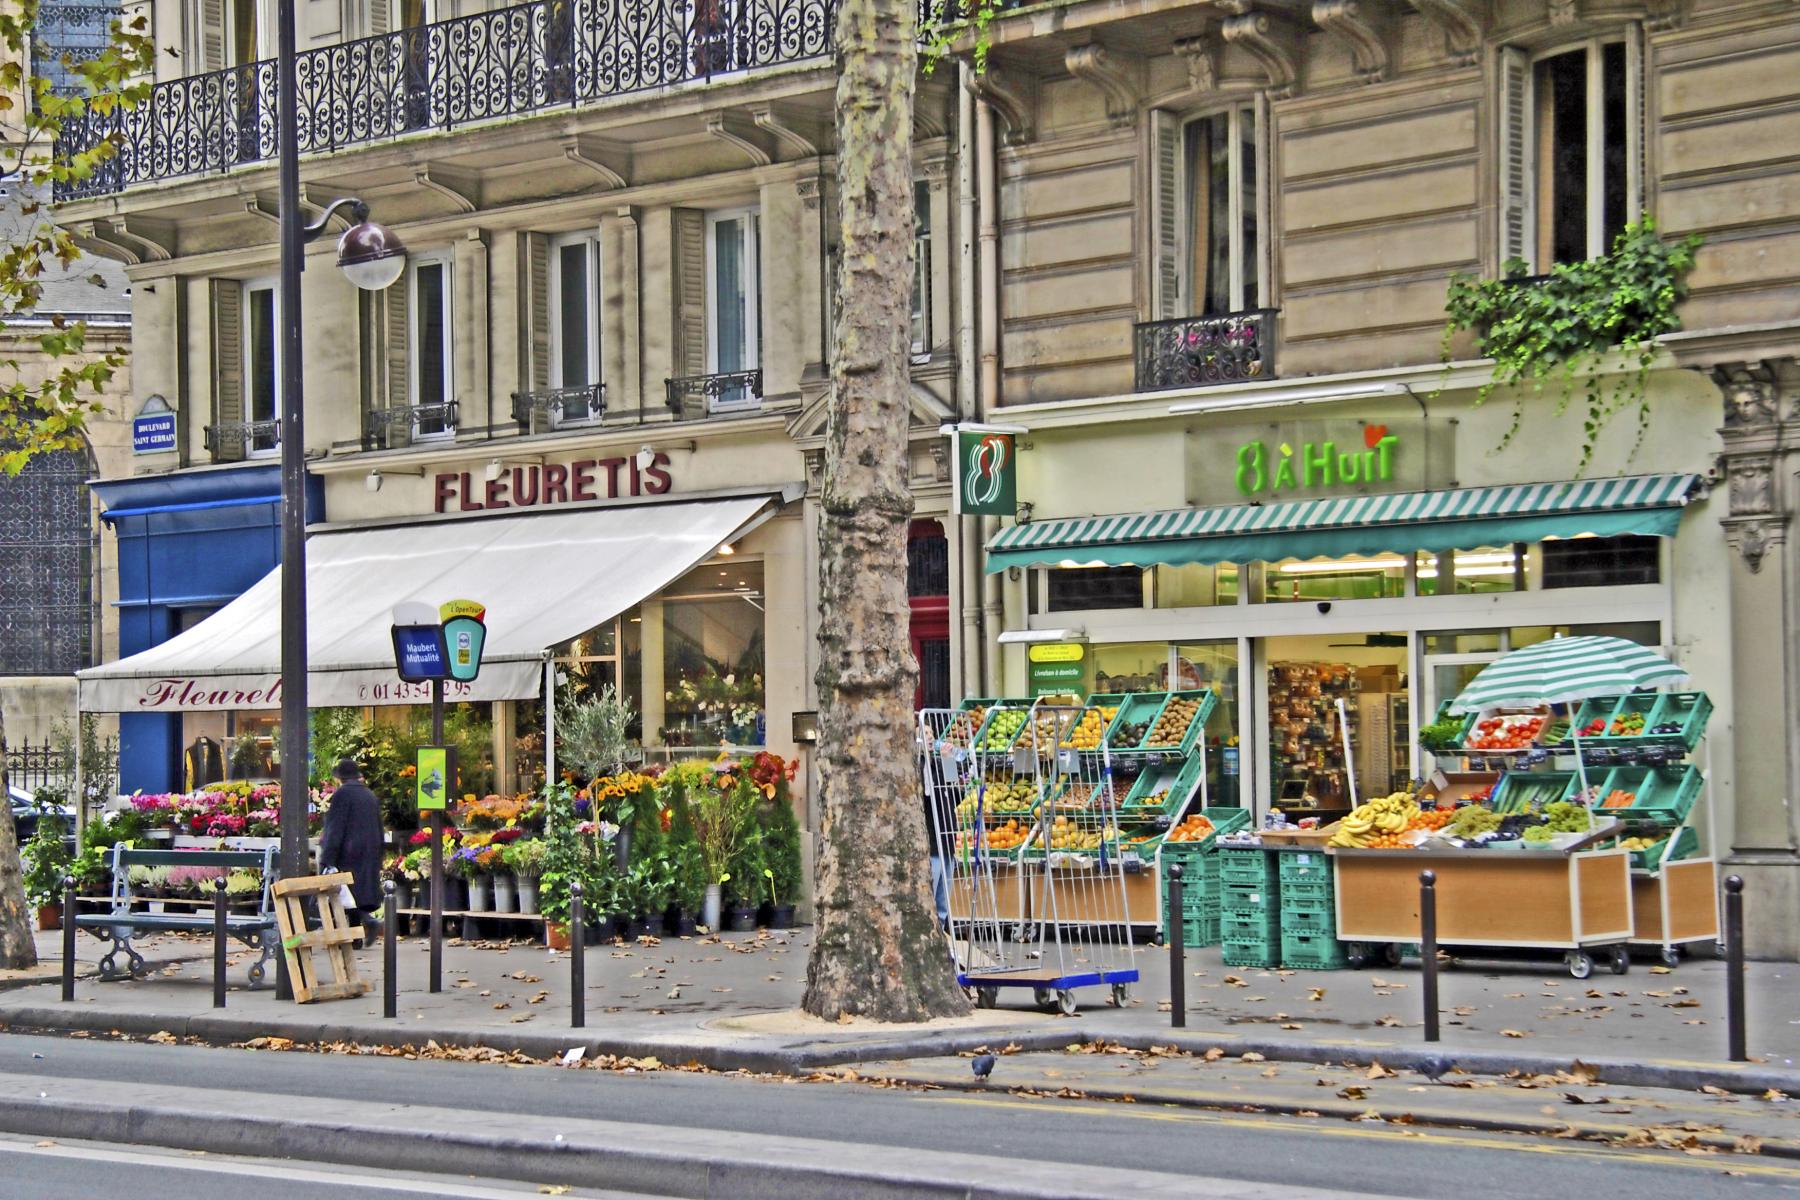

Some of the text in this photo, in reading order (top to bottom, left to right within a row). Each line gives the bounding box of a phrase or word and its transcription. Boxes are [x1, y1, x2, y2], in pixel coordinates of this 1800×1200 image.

[138, 422, 170, 432] BOULEVARD
[134, 434, 175, 445] SAINT GERMAIN
[1235, 441, 1268, 496] 8
[434, 452, 673, 513] FLEURETIS
[406, 643, 436, 652] Maubert
[406, 653, 440, 662] Mutualité
[374, 683, 388, 699] 01
[394, 683, 409, 698] 43
[414, 682, 429, 697] 54
[455, 680, 471, 695] 95
